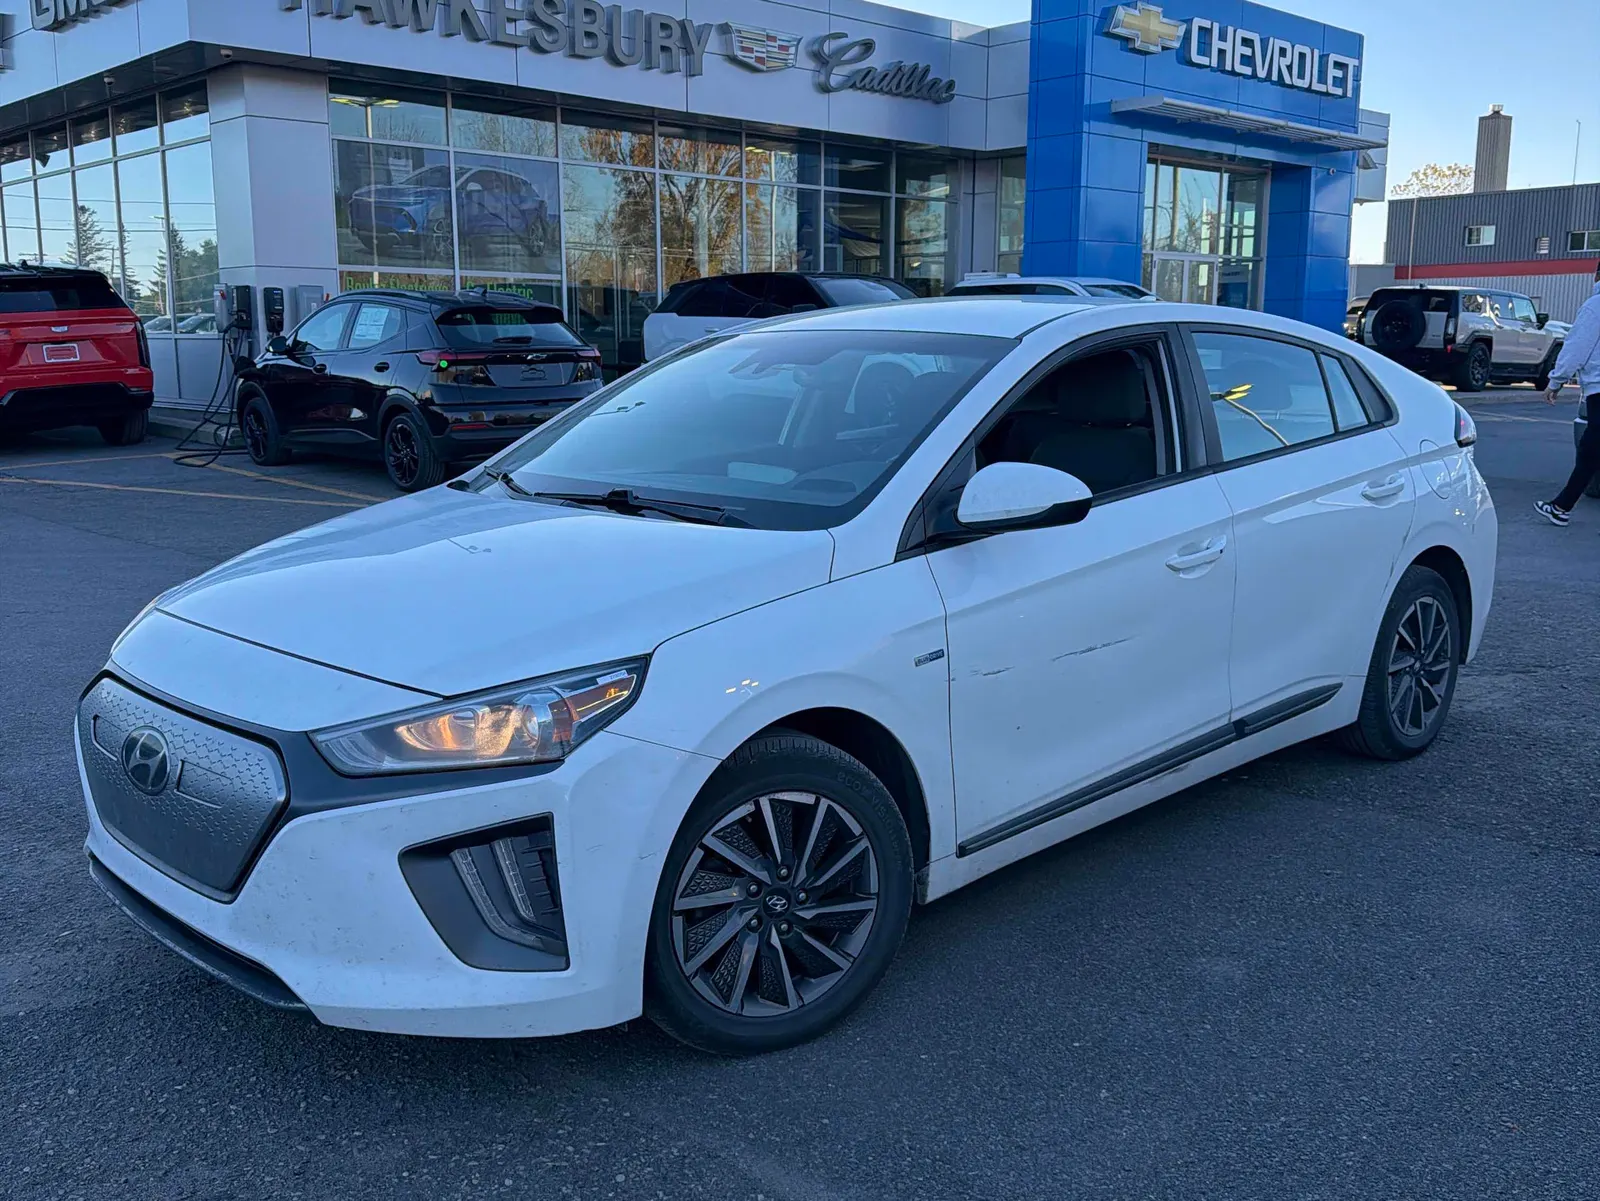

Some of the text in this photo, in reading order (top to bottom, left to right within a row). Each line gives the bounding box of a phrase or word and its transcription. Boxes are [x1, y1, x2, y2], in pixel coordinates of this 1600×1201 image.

[29, 0, 112, 33] GM
[280, 0, 714, 77] WKESBURY
[806, 31, 956, 104] Cadillac
[1190, 16, 1359, 98] CHEVROLET
